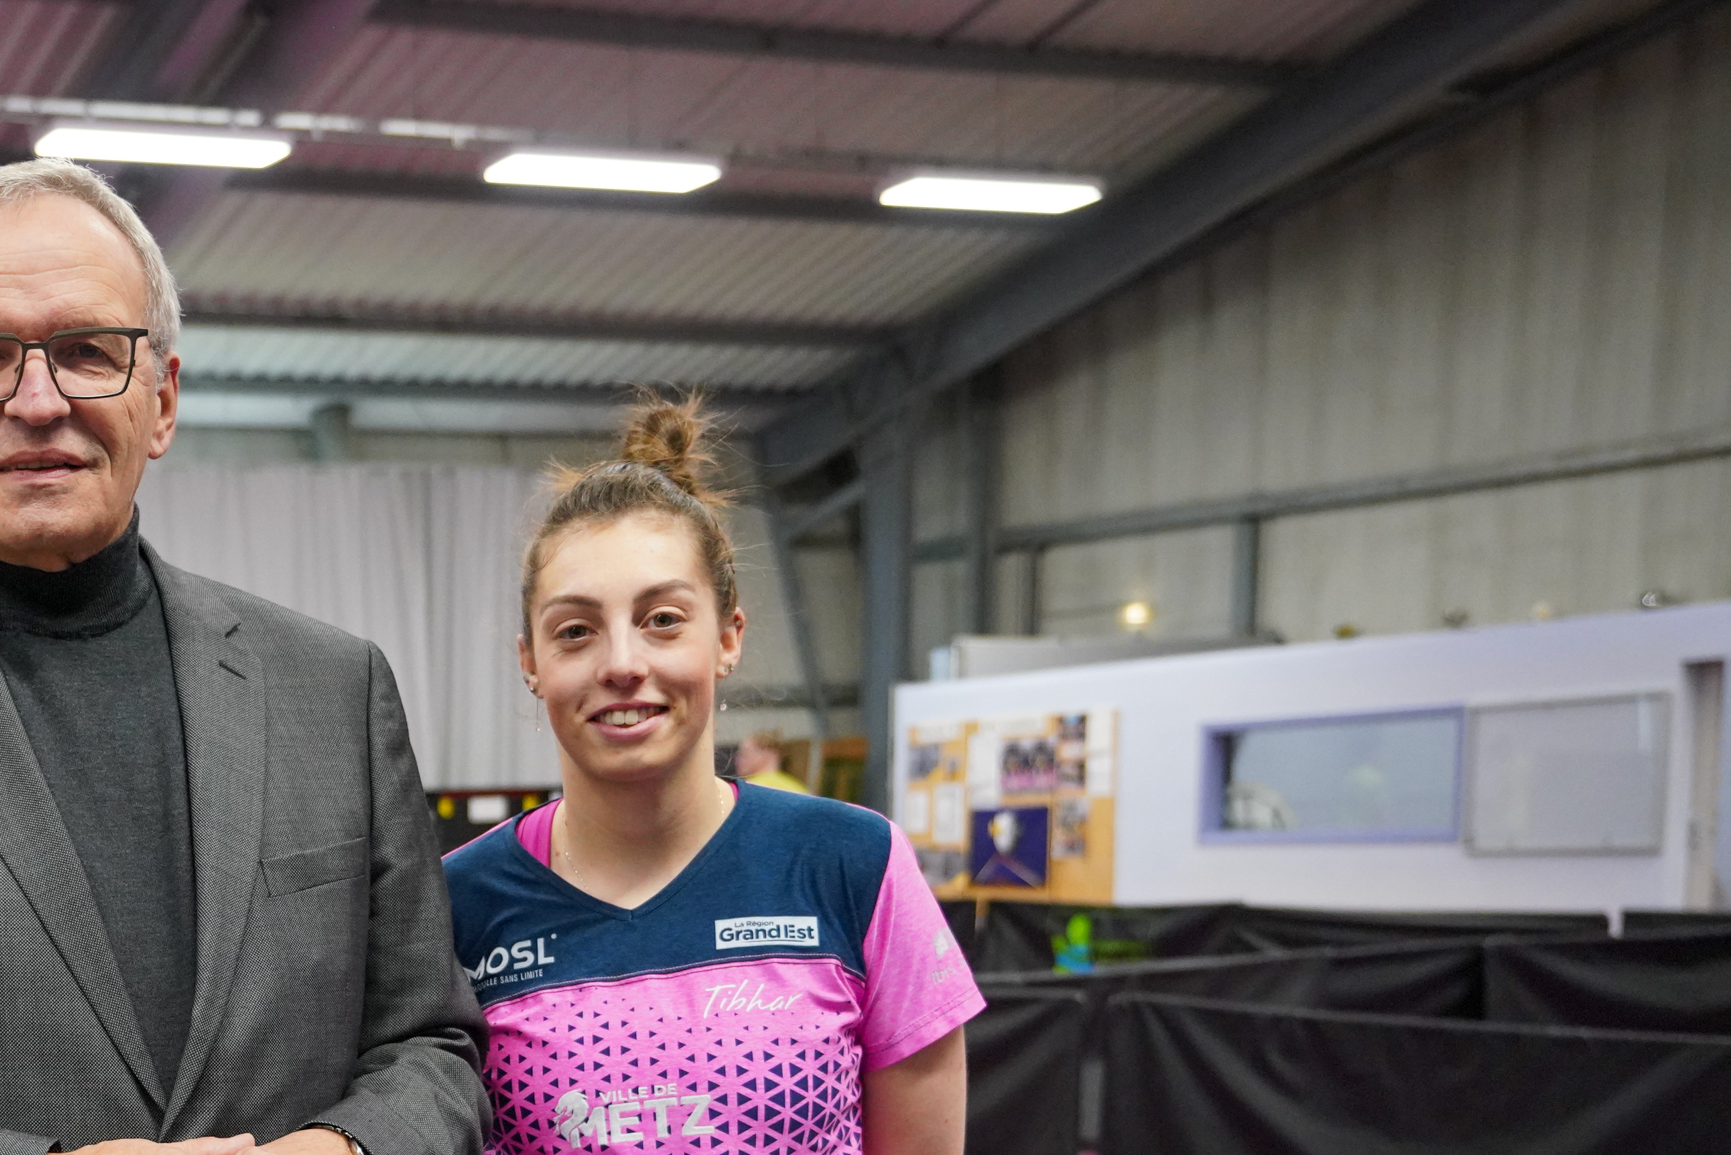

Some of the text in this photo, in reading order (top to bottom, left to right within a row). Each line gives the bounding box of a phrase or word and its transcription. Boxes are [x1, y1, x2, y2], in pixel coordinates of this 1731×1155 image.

[719, 924, 815, 942] Grand Est
[746, 920, 774, 928] Région
[499, 973, 519, 985] SANS
[520, 968, 544, 982] LIMITE
[703, 979, 803, 1019] Tibhar
[599, 1083, 678, 1104] VILLE DE
[571, 1094, 715, 1149] METZ
